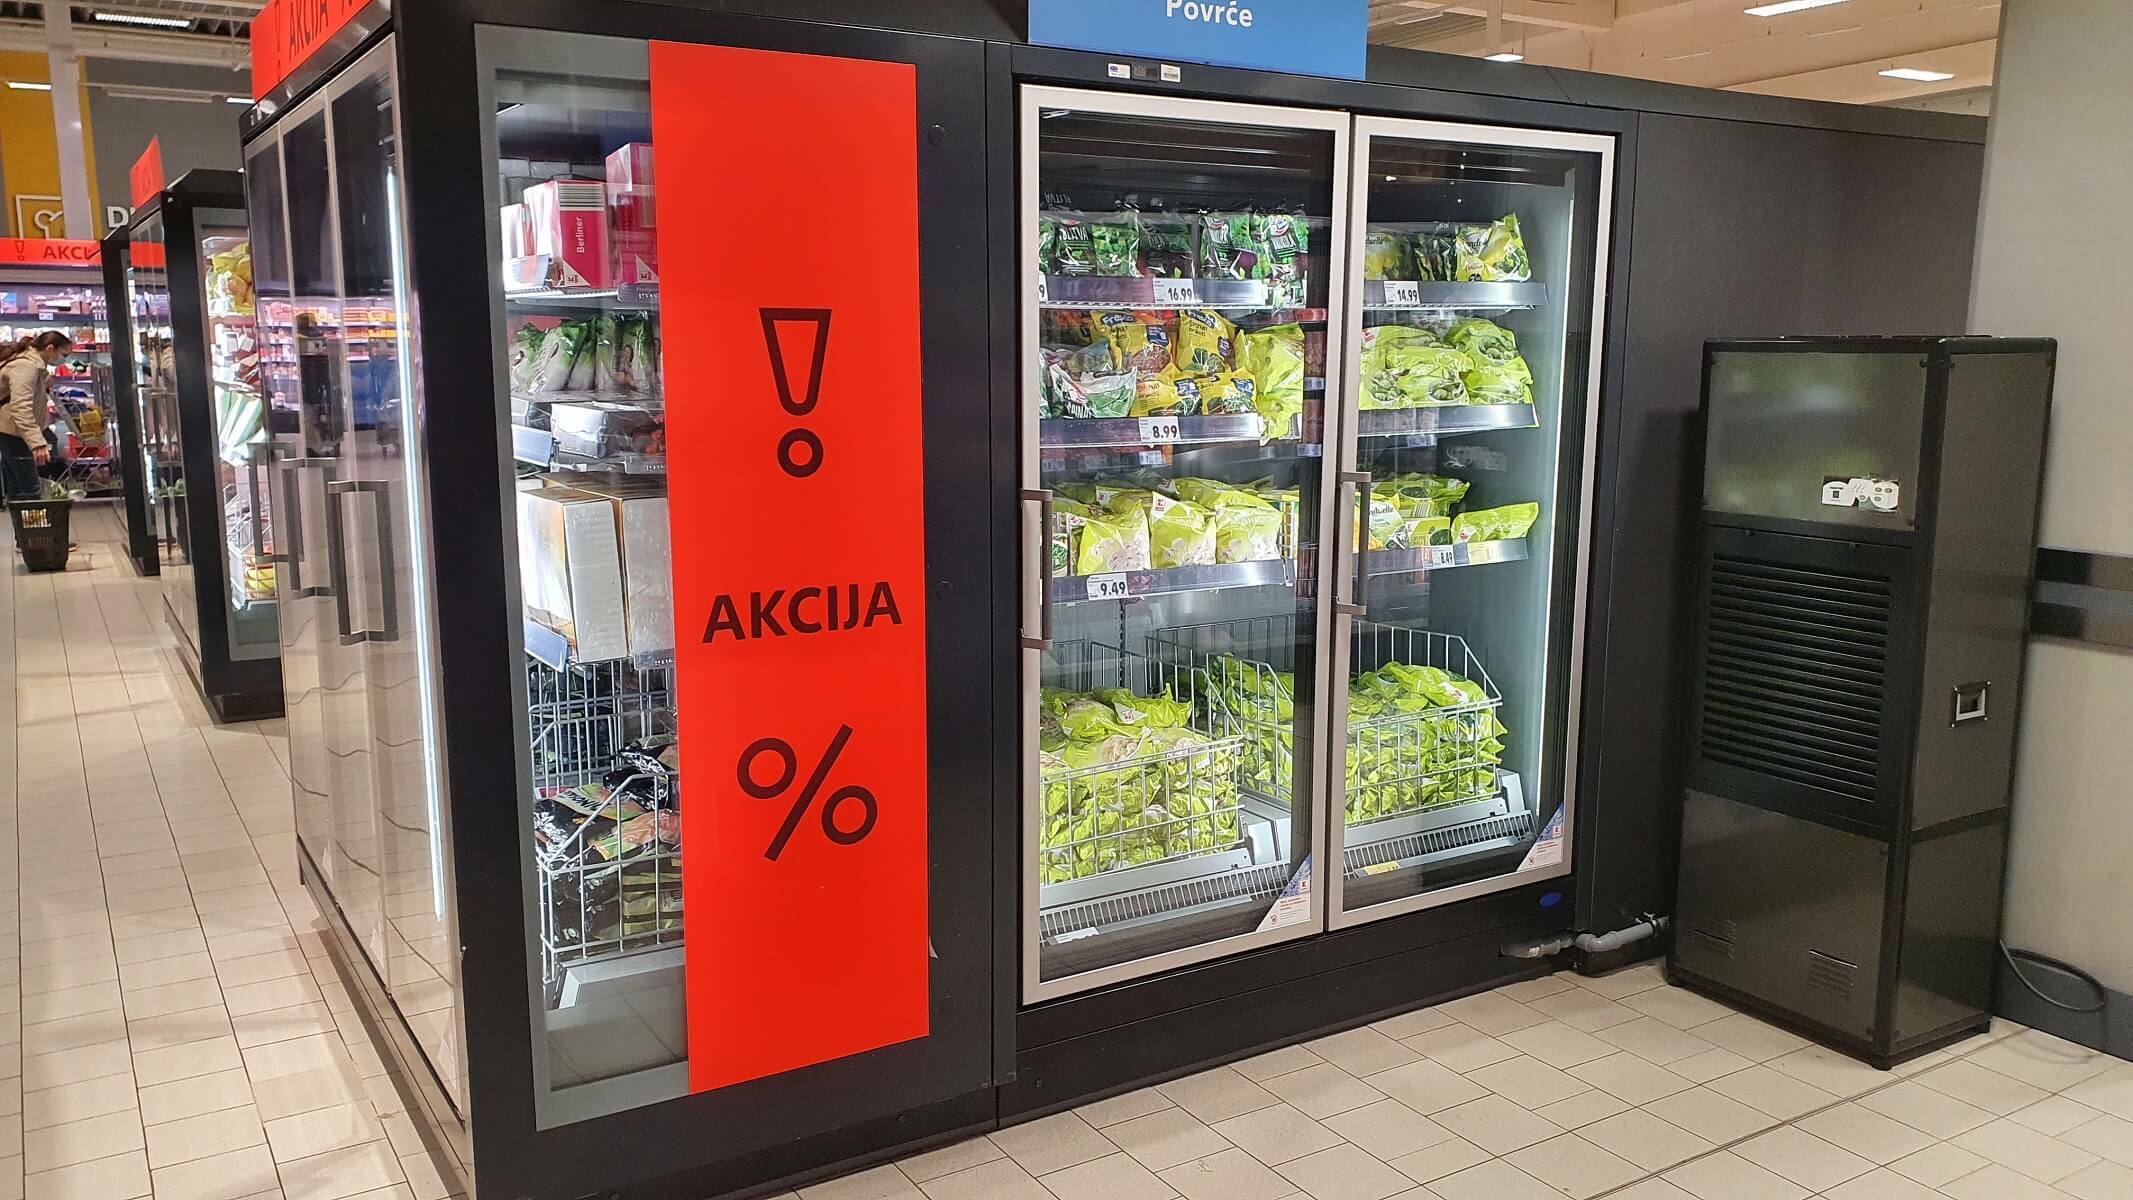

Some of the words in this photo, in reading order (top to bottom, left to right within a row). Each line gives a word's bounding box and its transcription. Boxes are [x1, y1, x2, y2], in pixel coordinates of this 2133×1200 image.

[1166, 0, 1253, 28] Povrće
[575, 216, 585, 253] Berliner
[1168, 287, 1193, 301] 16.99
[1397, 289, 1418, 302] 14.99
[1152, 425, 1178, 439] 8.99
[1100, 581, 1126, 596] 9.49
[702, 581, 903, 644] AKCIJA
